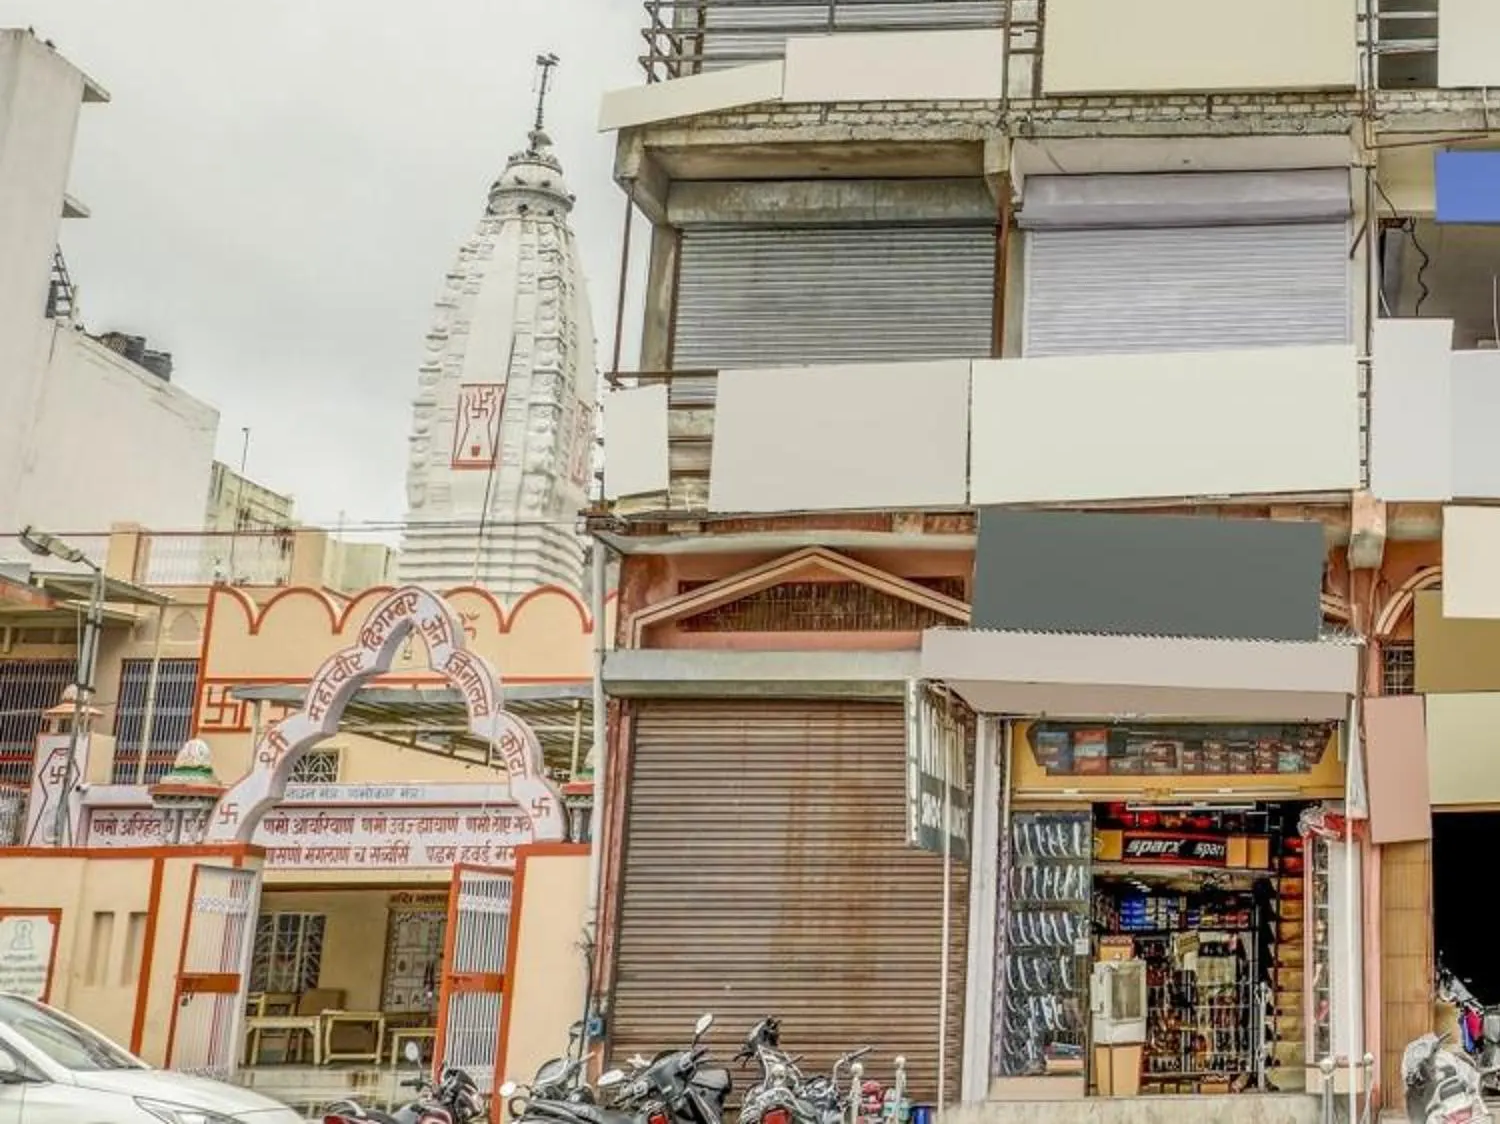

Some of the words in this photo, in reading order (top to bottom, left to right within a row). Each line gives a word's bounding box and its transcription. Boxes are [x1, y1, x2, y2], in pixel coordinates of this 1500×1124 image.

[308, 652, 365, 721] महावीर
[361, 591, 419, 653] दिगम्बर
[421, 614, 449, 648] जैन
[444, 651, 490, 717] जिनालय
[499, 728, 529, 780] कोटा
[1126, 839, 1186, 856] sparx
